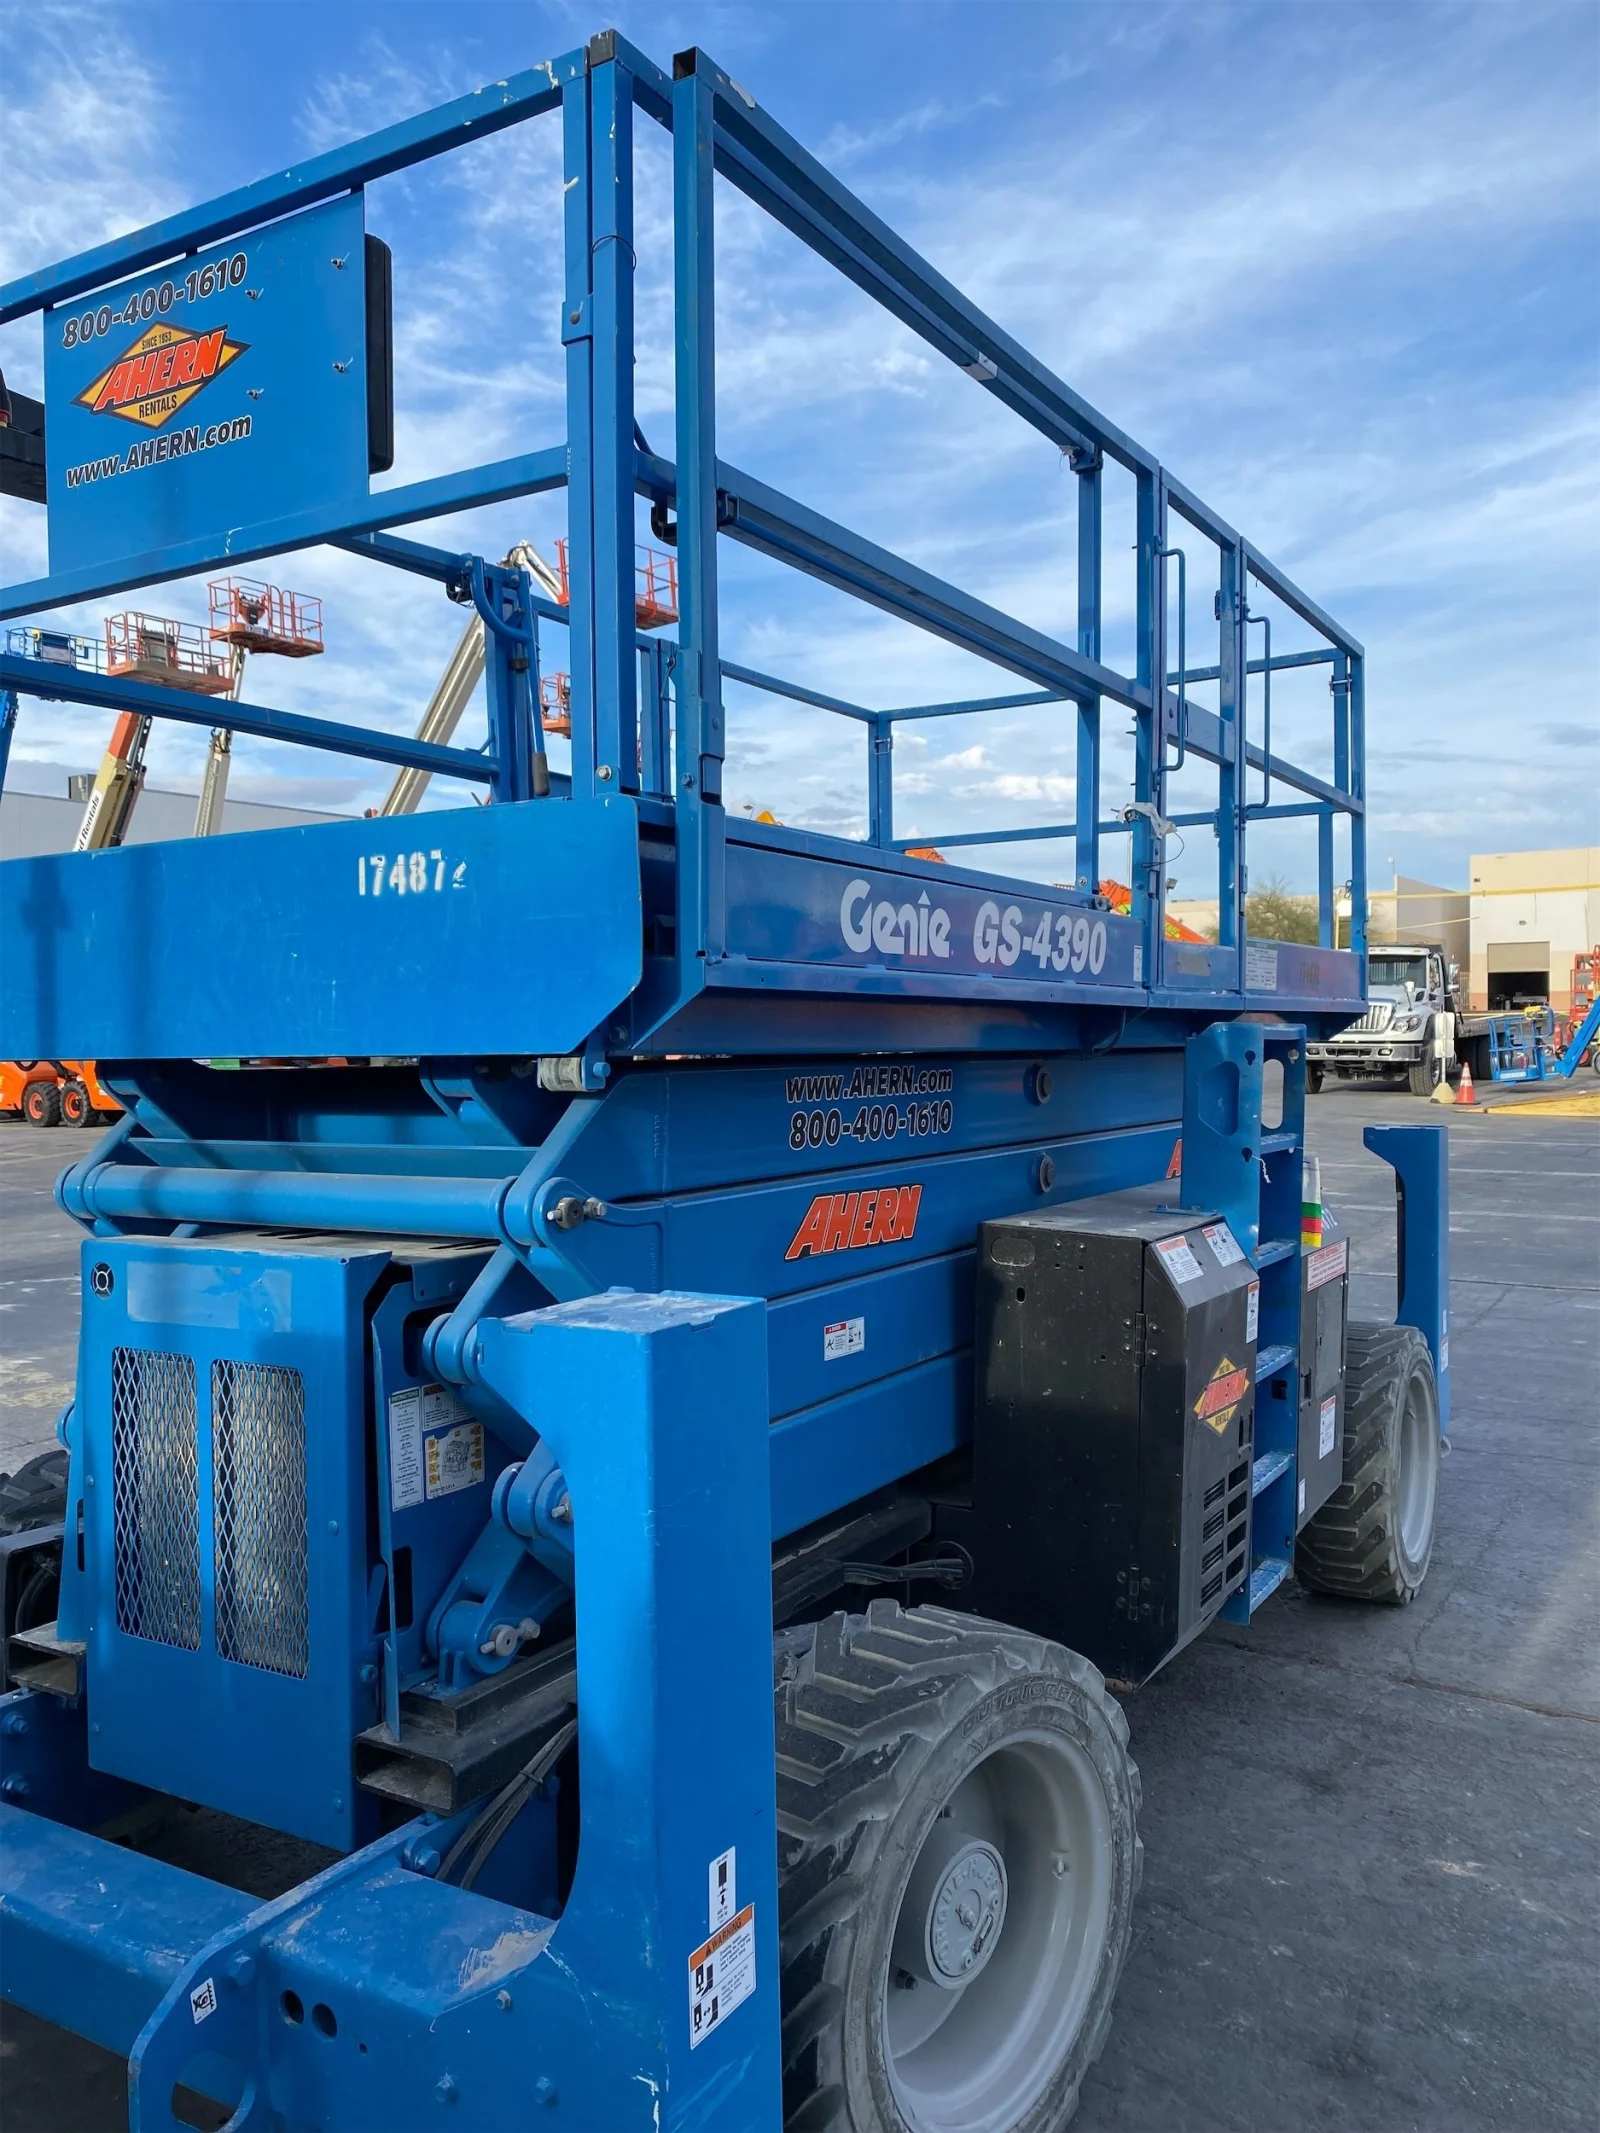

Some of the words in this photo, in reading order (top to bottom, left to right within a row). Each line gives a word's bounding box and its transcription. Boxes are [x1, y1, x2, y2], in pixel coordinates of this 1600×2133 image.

[63, 252, 247, 349] 800-400-1610
[142, 335, 157, 350] SINCE
[93, 330, 225, 411] AHERN
[139, 394, 177, 418] RENTALS
[66, 415, 252, 488] www.AHERN.com
[81, 795, 100, 840] Rentals
[840, 878, 951, 958] Genie
[973, 901, 1107, 975] GS-4390
[786, 1065, 953, 1103] www.AHERN.com
[789, 1100, 953, 1150] 800-400-1610
[785, 1185, 923, 1260] AHERN
[712, 1917, 742, 1949] WARNING
